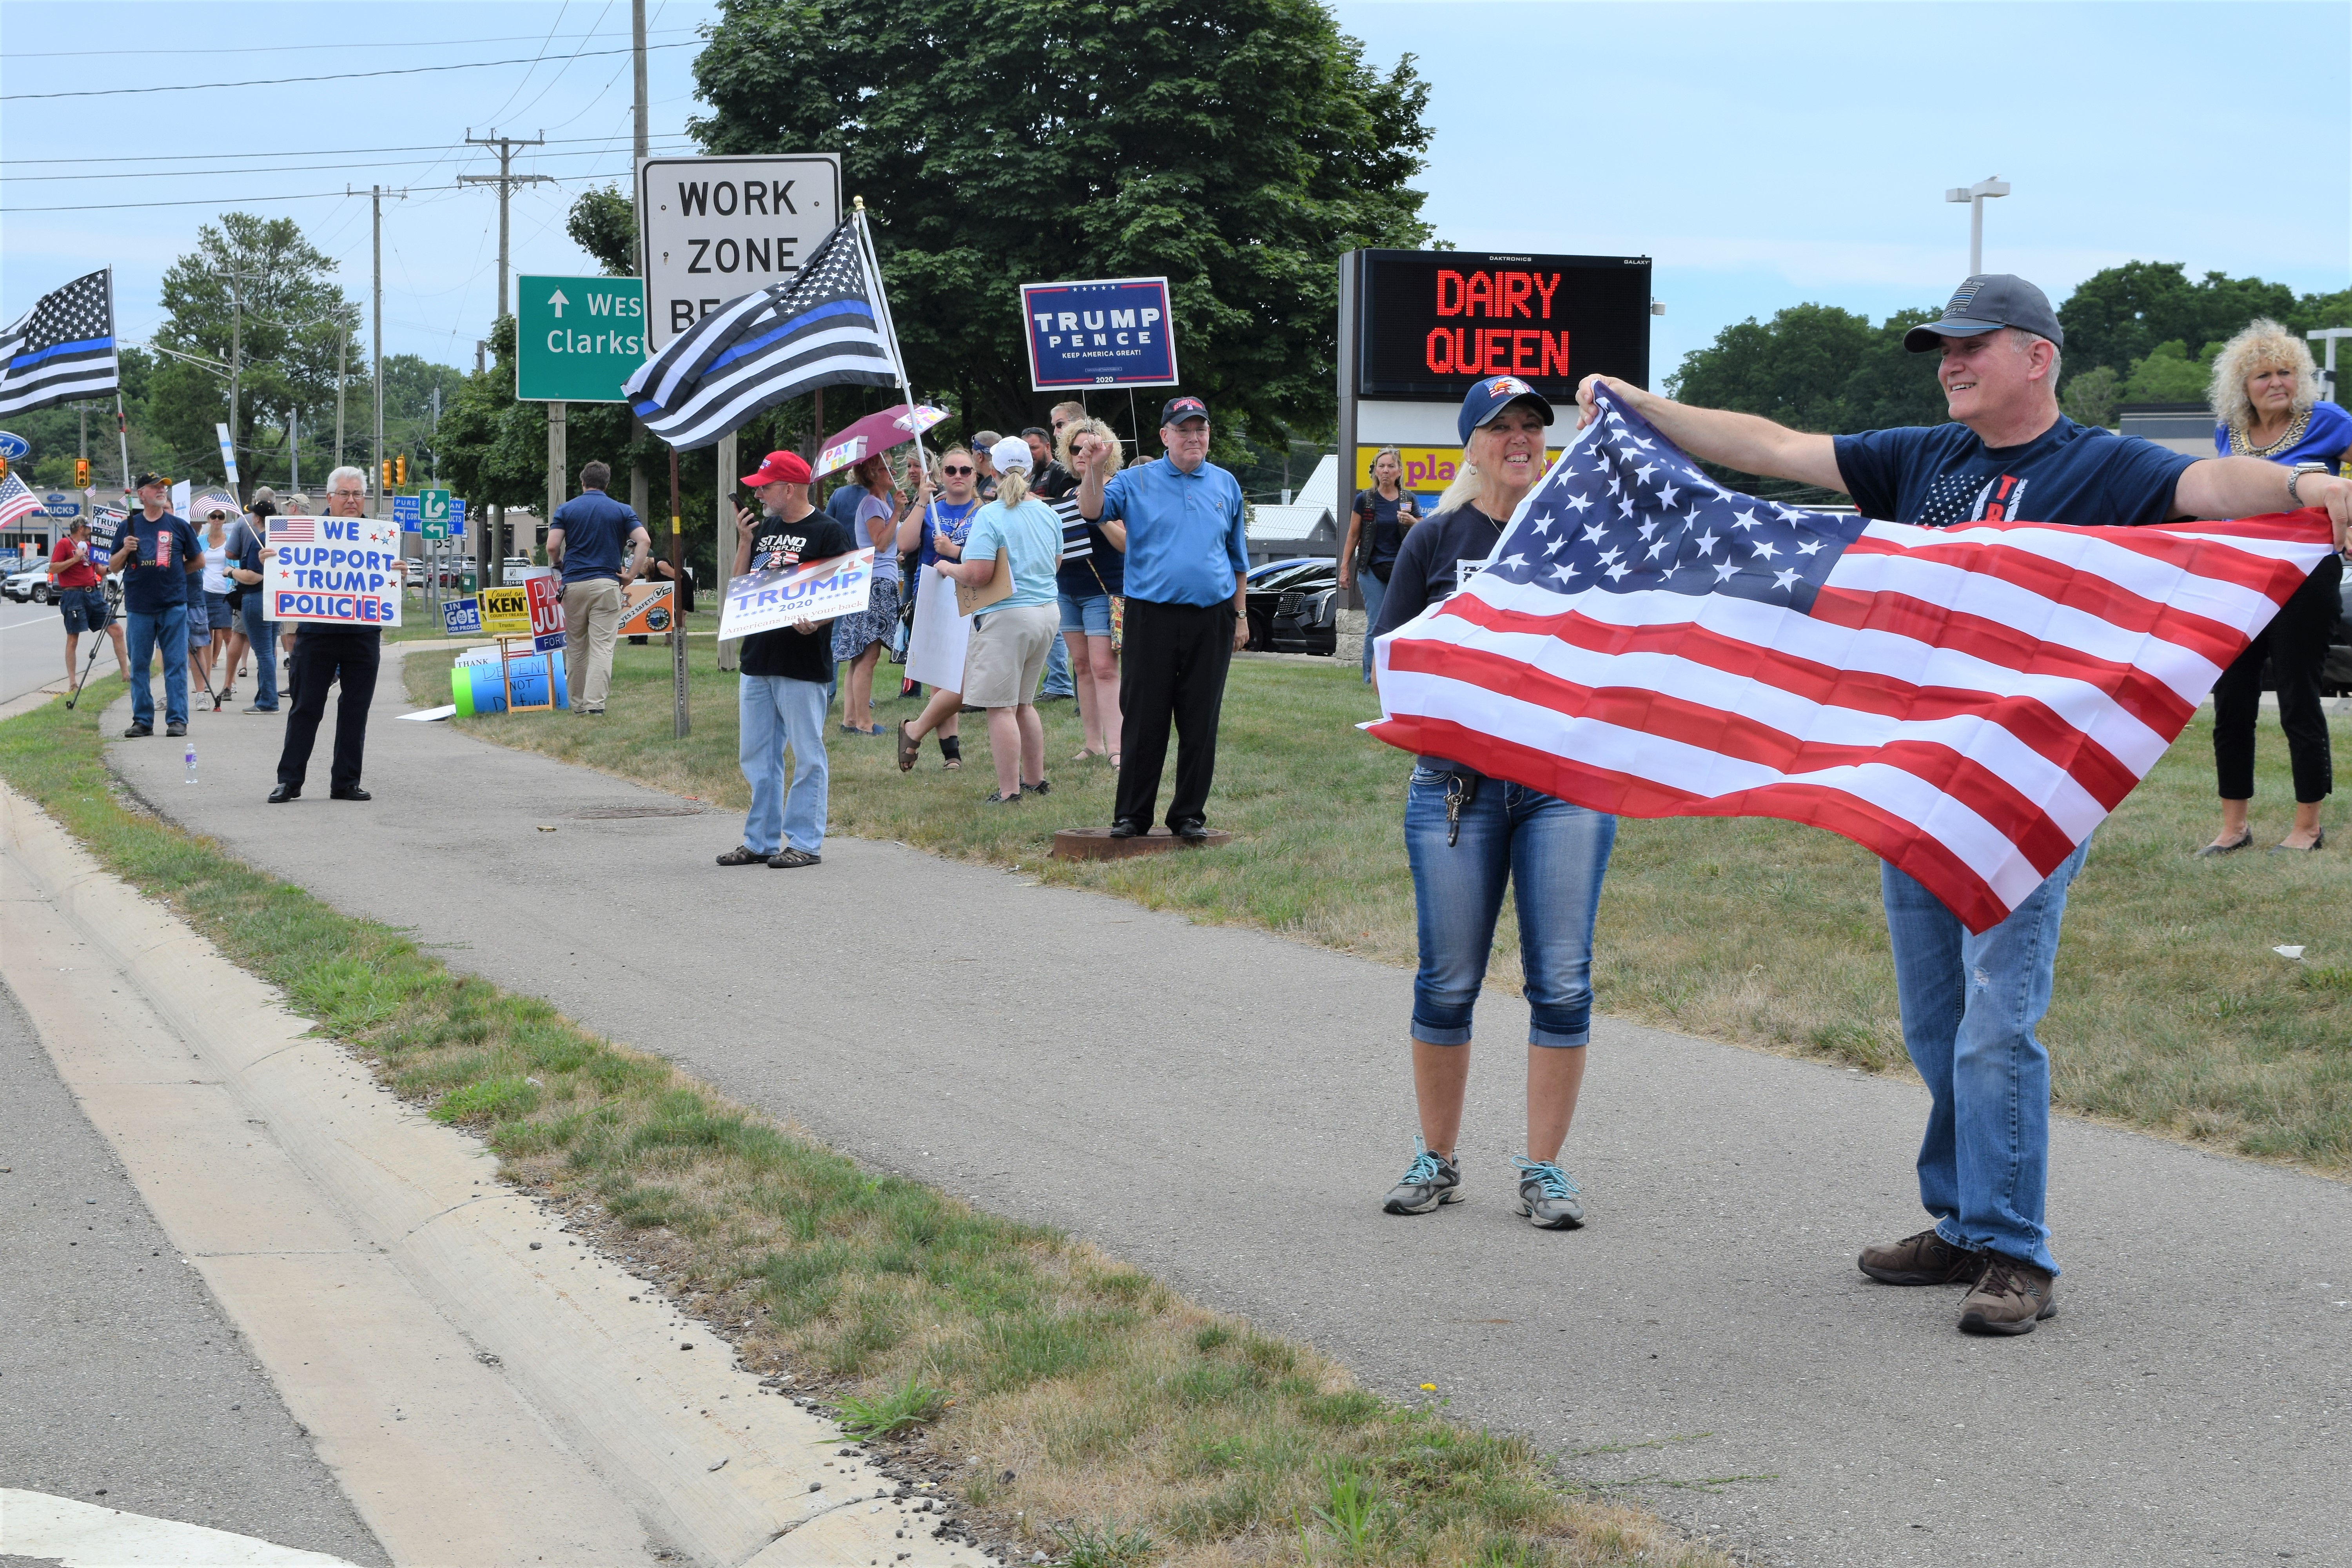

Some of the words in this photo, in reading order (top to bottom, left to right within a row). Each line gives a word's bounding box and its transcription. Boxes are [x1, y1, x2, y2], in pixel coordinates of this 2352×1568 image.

[679, 180, 797, 216] WORK
[688, 238, 799, 273] ZONE
[1437, 270, 1561, 318] DAIRY
[1034, 308, 1160, 332] TRUMP
[1049, 332, 1151, 348] PENCE
[1426, 328, 1568, 376] QUEEN
[826, 442, 851, 461] PAY
[829, 455, 846, 470] 'EM
[323, 521, 360, 541] WE
[91, 535, 98, 544] WE
[98, 537, 113, 548] SUPPO
[759, 535, 807, 547] STAND
[278, 547, 395, 572] SUPPORT
[294, 570, 385, 592] TRUMP
[492, 590, 512, 599] Count
[733, 572, 862, 611] TRUMP
[279, 594, 394, 621] POLICIES
[443, 602, 461, 612] LIN
[621, 613, 631, 621] YES
[635, 597, 654, 612] SAFETY
[779, 599, 813, 612] 2020
[647, 620, 668, 630] TOWNSHIP
[725, 618, 781, 634] Americans
[784, 612, 808, 621] have
[811, 607, 836, 617] your
[838, 601, 864, 610] back
[544, 638, 561, 647] FOR
[457, 658, 489, 668] THANK
[483, 661, 555, 679] DEFEND
[509, 679, 534, 691] NOT
